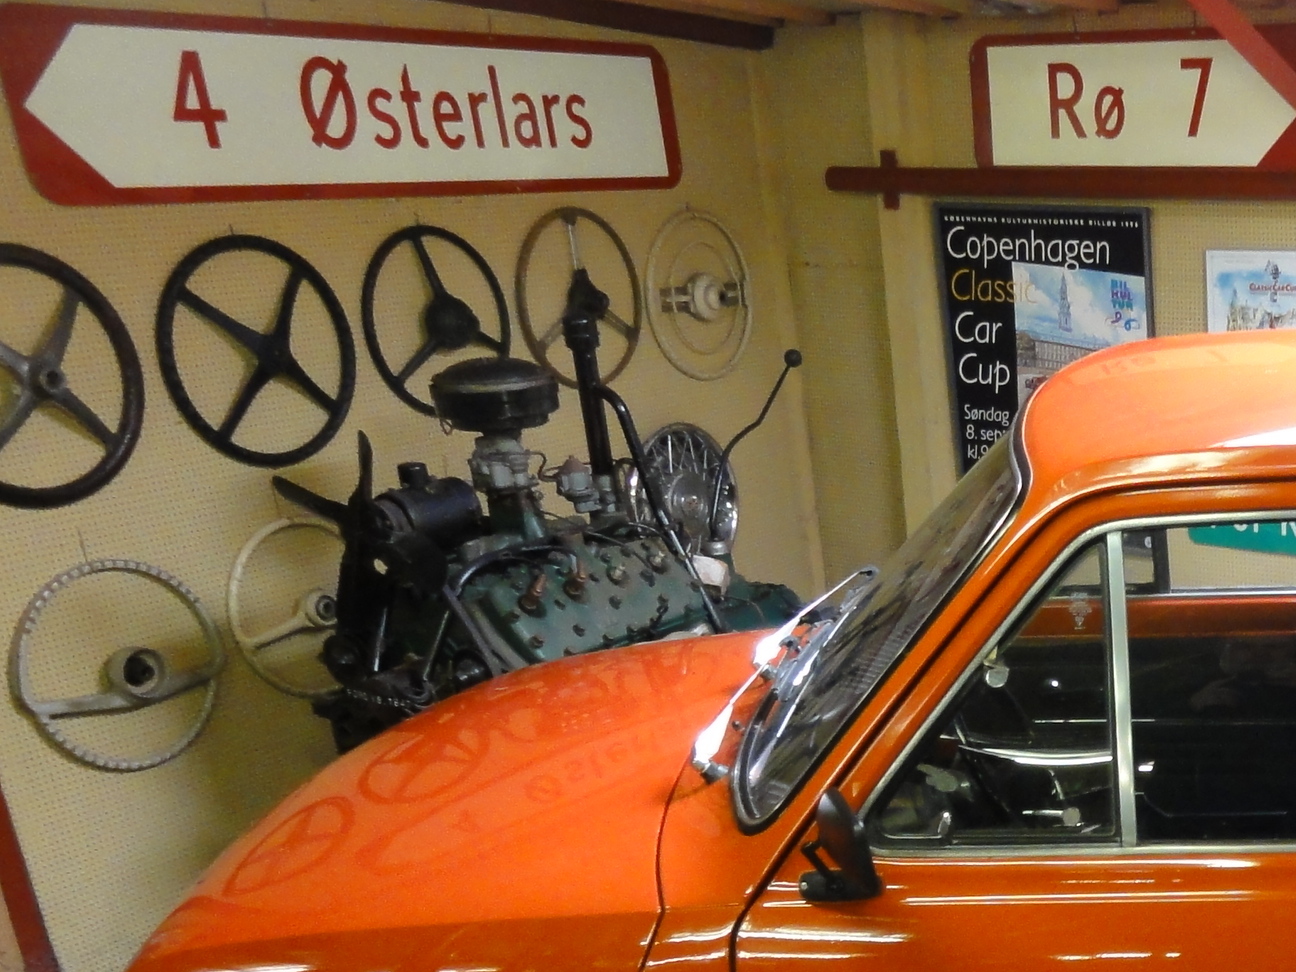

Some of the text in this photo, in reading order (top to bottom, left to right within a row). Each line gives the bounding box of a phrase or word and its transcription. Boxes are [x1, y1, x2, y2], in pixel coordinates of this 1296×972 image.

[172, 51, 593, 150] 4 Østerlars
[1047, 57, 1214, 140] Rø 7
[947, 226, 1110, 270] Copenhagen
[951, 269, 1038, 304] Classic
[955, 311, 1002, 344] Car
[959, 353, 1010, 394] Cup
[964, 404, 1010, 426] Søndag
